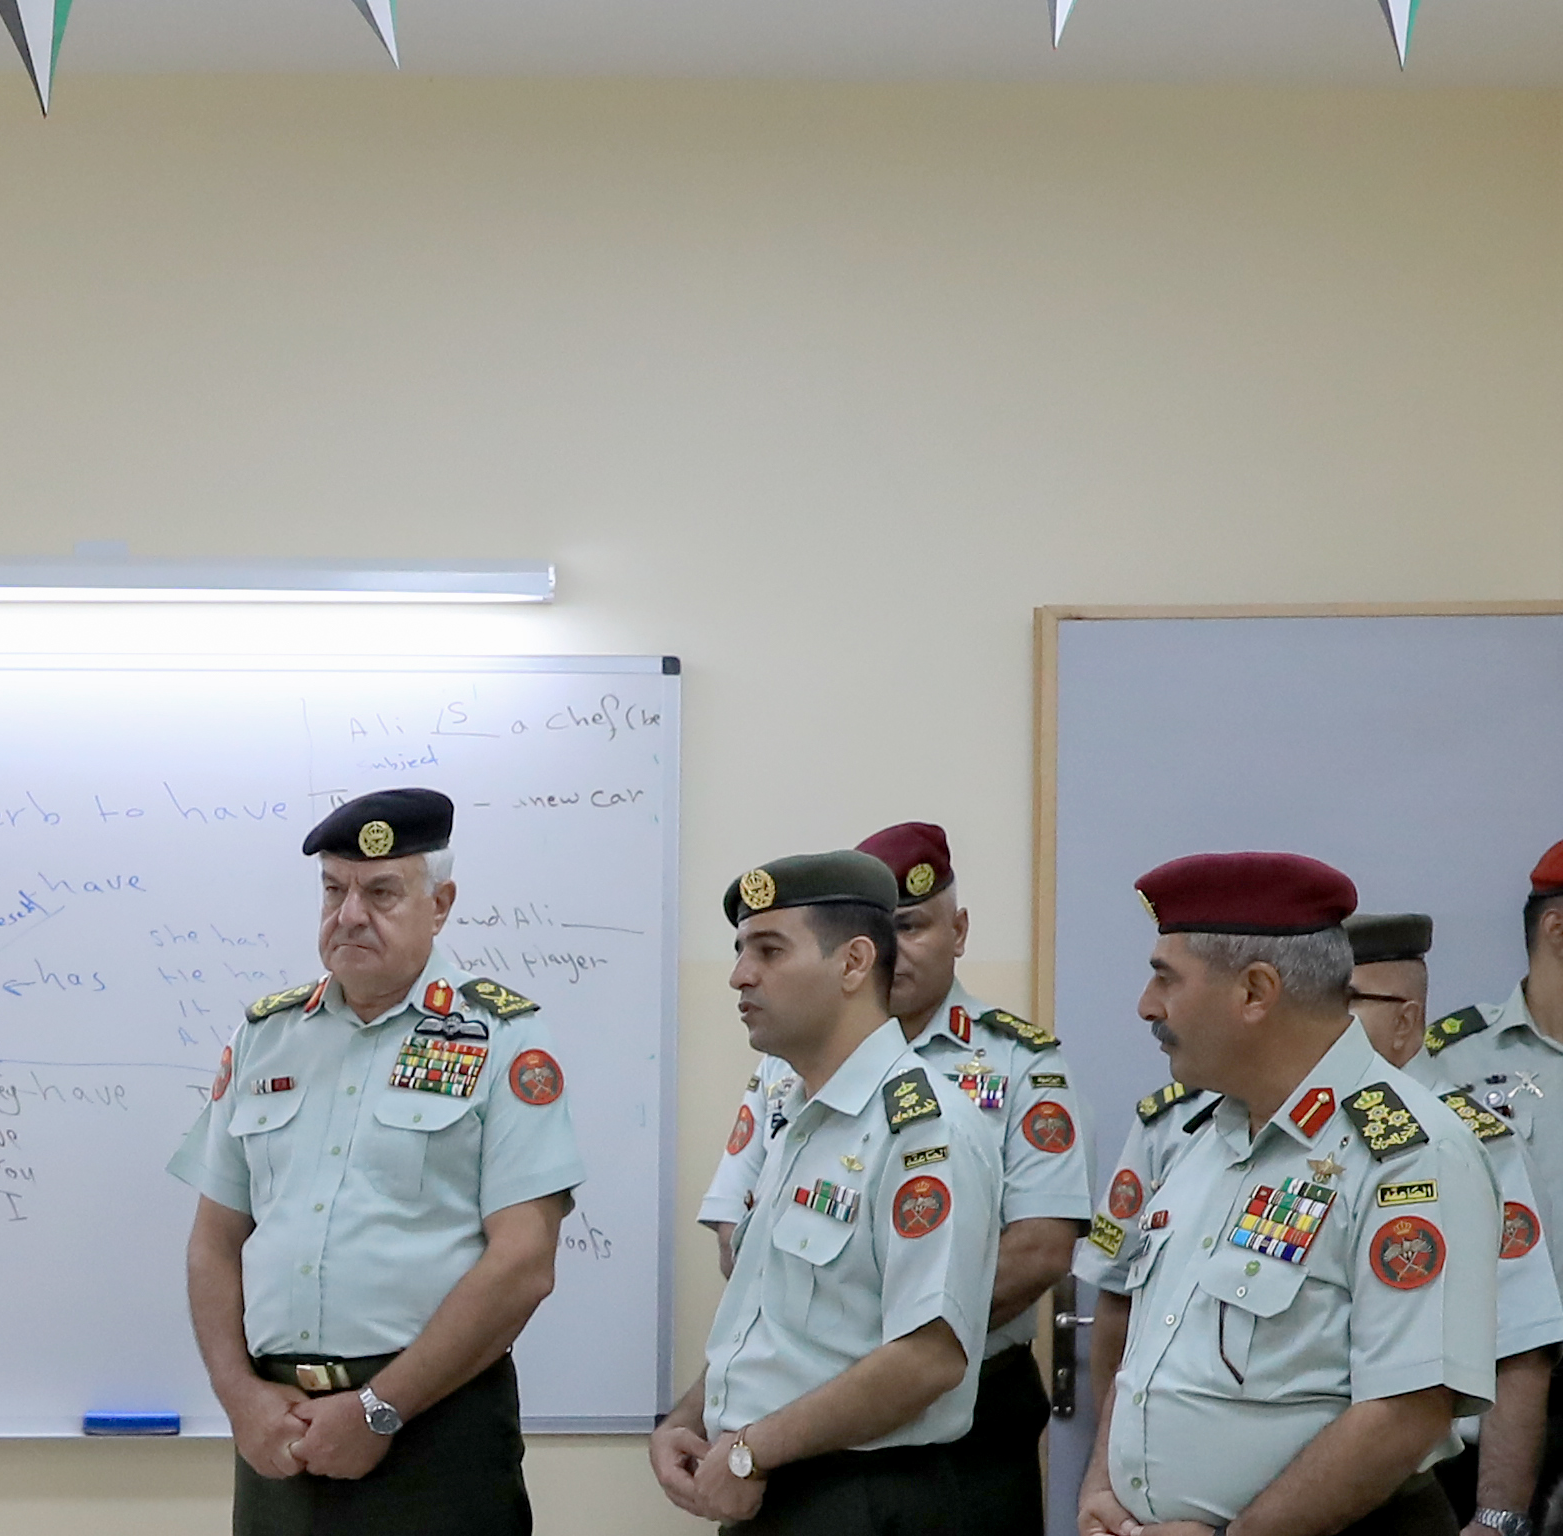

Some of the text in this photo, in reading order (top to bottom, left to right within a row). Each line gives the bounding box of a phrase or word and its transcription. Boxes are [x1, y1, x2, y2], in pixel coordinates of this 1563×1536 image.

[349, 712, 405, 742] Ali
[93, 793, 145, 824] to
[162, 780, 290, 825] have
[36, 870, 148, 896] have
[513, 902, 555, 929] Ali
[210, 922, 271, 949] has
[32, 958, 107, 994] has
[157, 962, 290, 987] He has
[28, 1070, 130, 1113] have
[558, 1211, 613, 1260] ooks
